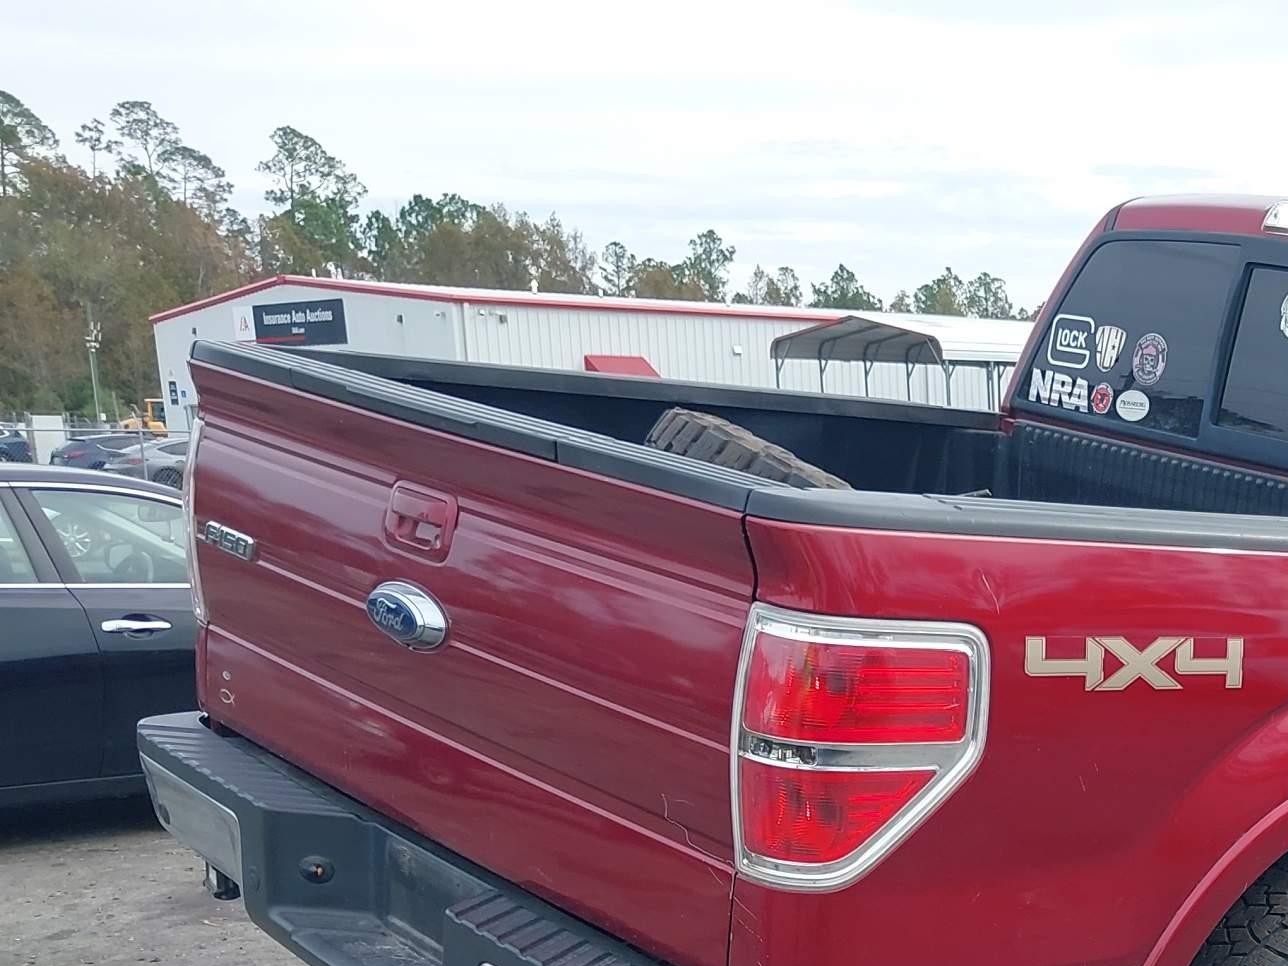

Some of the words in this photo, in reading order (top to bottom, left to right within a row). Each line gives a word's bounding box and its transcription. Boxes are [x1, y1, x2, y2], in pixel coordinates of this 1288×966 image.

[263, 312, 291, 325] Insurance
[292, 310, 306, 323] Auto
[306, 308, 333, 322] Auctions
[1047, 313, 1095, 369] GLOCK
[1028, 367, 1089, 413] NRA
[373, 597, 405, 632] Ford
